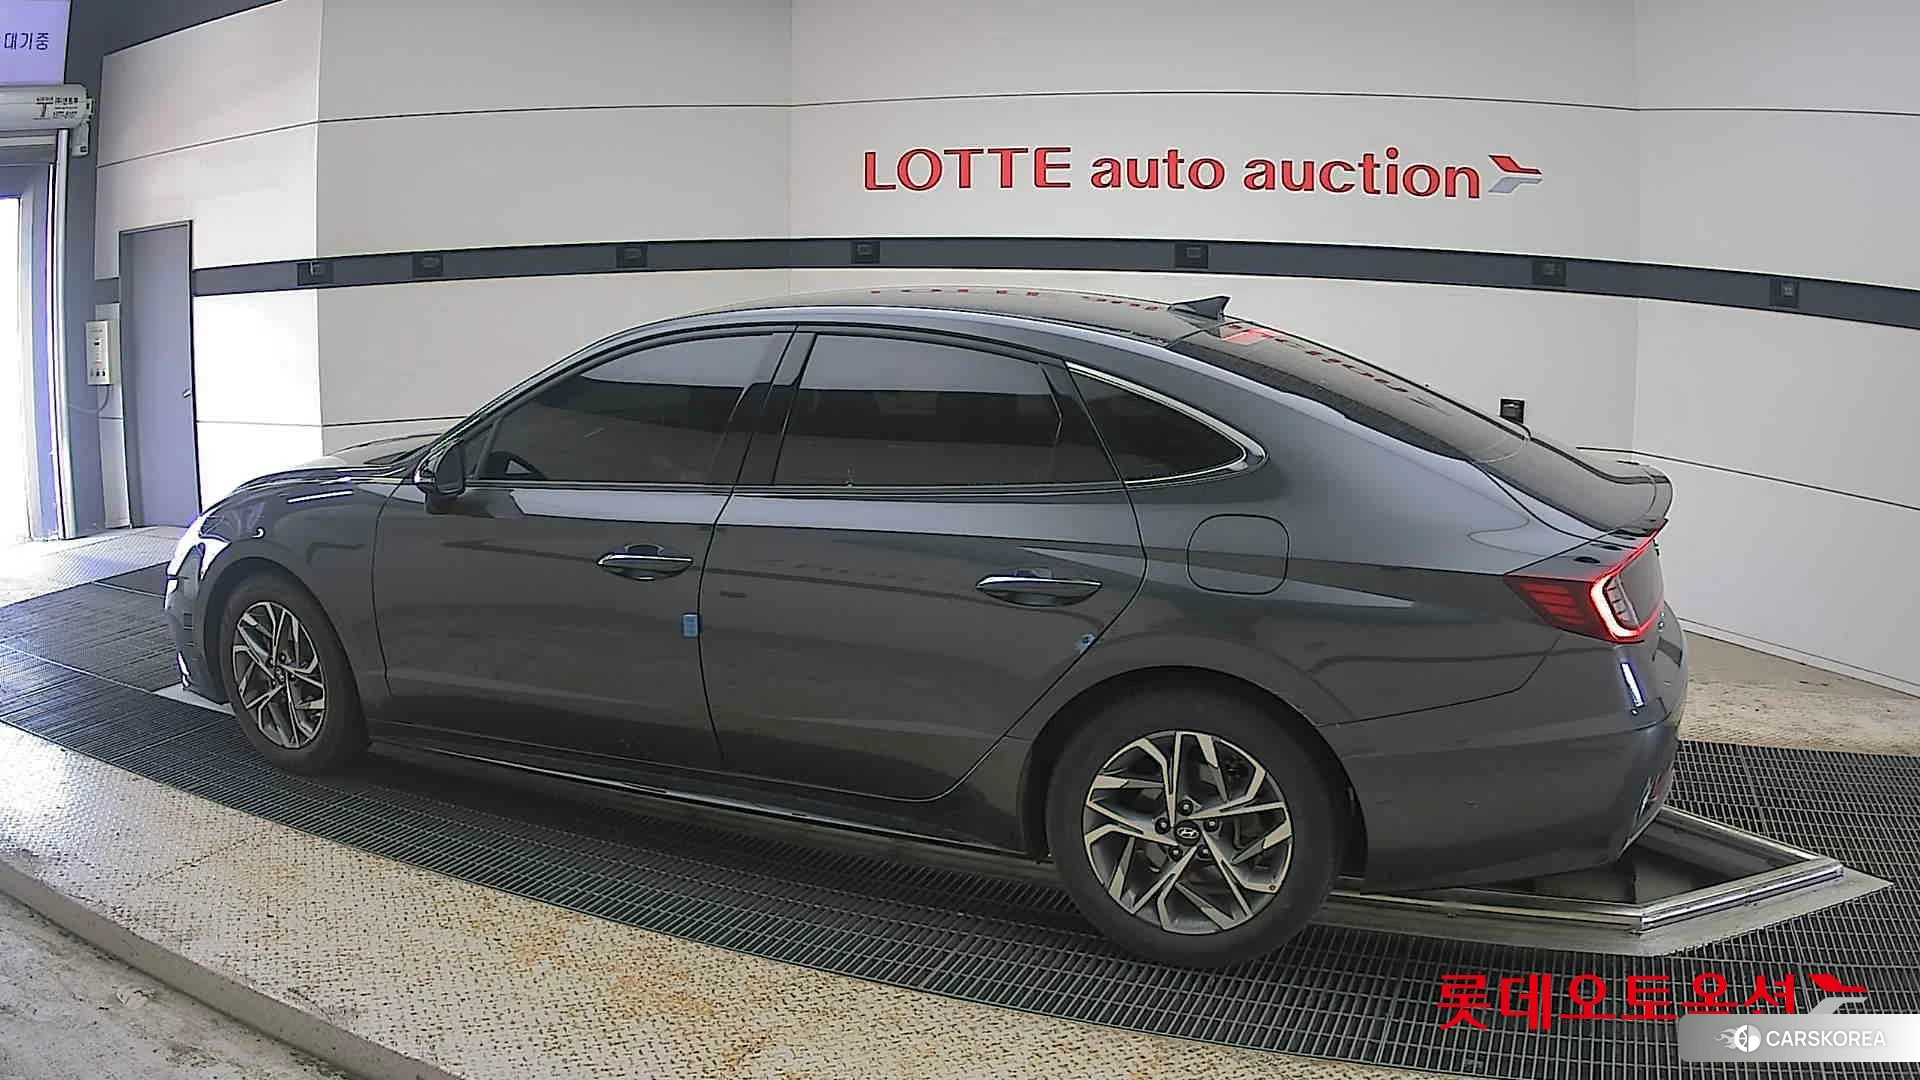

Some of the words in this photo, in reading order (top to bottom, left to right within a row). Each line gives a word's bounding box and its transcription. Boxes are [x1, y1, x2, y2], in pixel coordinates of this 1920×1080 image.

[4, 31, 49, 50] 대기중
[863, 147, 1071, 190] LOTTE
[1090, 149, 1226, 191] auto
[1243, 146, 1481, 199] auction
